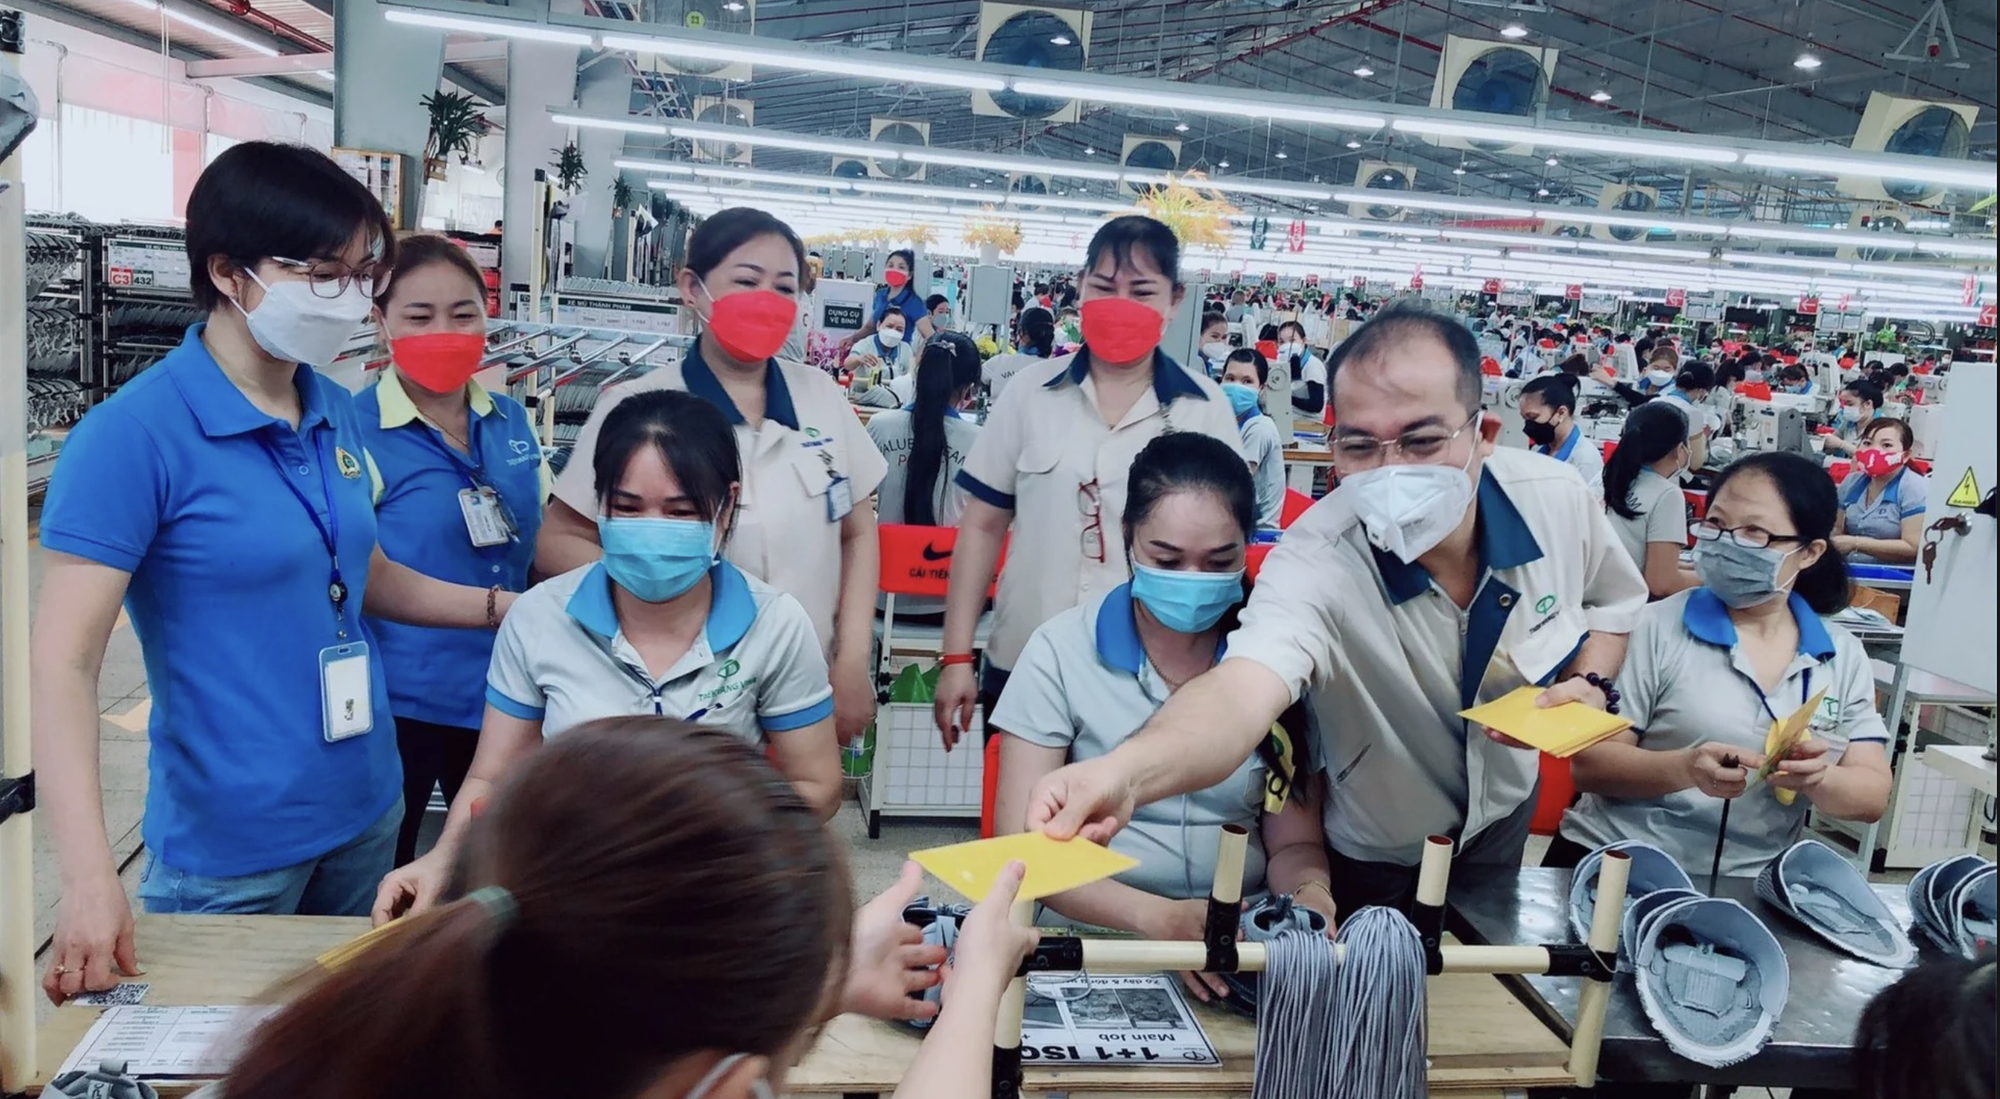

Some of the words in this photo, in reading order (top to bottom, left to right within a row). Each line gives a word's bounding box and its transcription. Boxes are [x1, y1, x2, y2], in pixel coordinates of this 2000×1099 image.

[112, 274, 130, 285] C3
[134, 277, 152, 285] 432
[1099, 1033, 1129, 1042] Job
[1132, 1033, 1176, 1042] Main
[1095, 1046, 1160, 1060] 1+1
